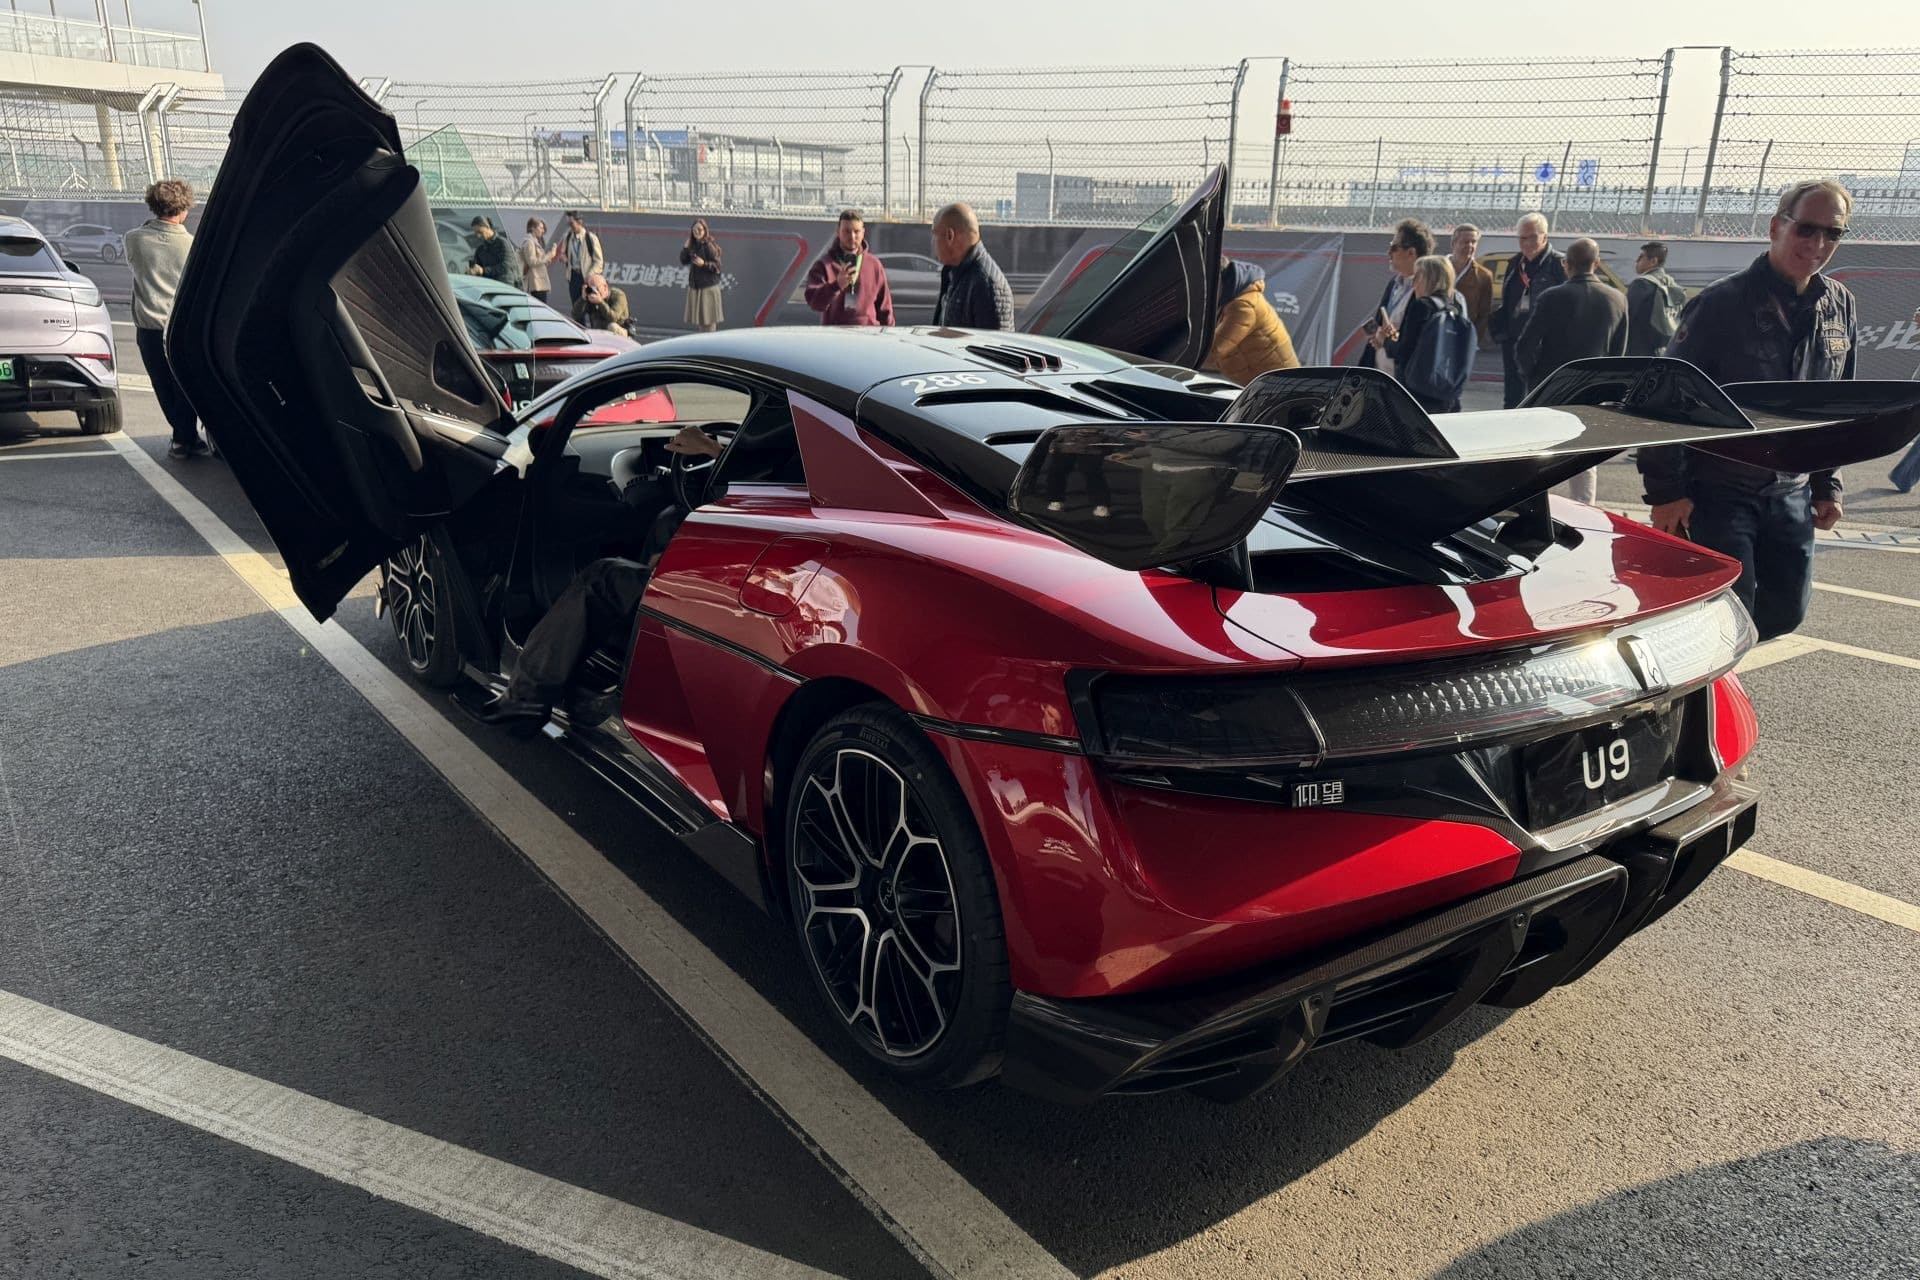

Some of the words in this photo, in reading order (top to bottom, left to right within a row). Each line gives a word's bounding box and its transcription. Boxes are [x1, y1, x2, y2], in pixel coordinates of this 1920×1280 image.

[900, 373, 987, 394] 286
[1582, 738, 1630, 790] U9
[1296, 781, 1343, 807] 仰望
